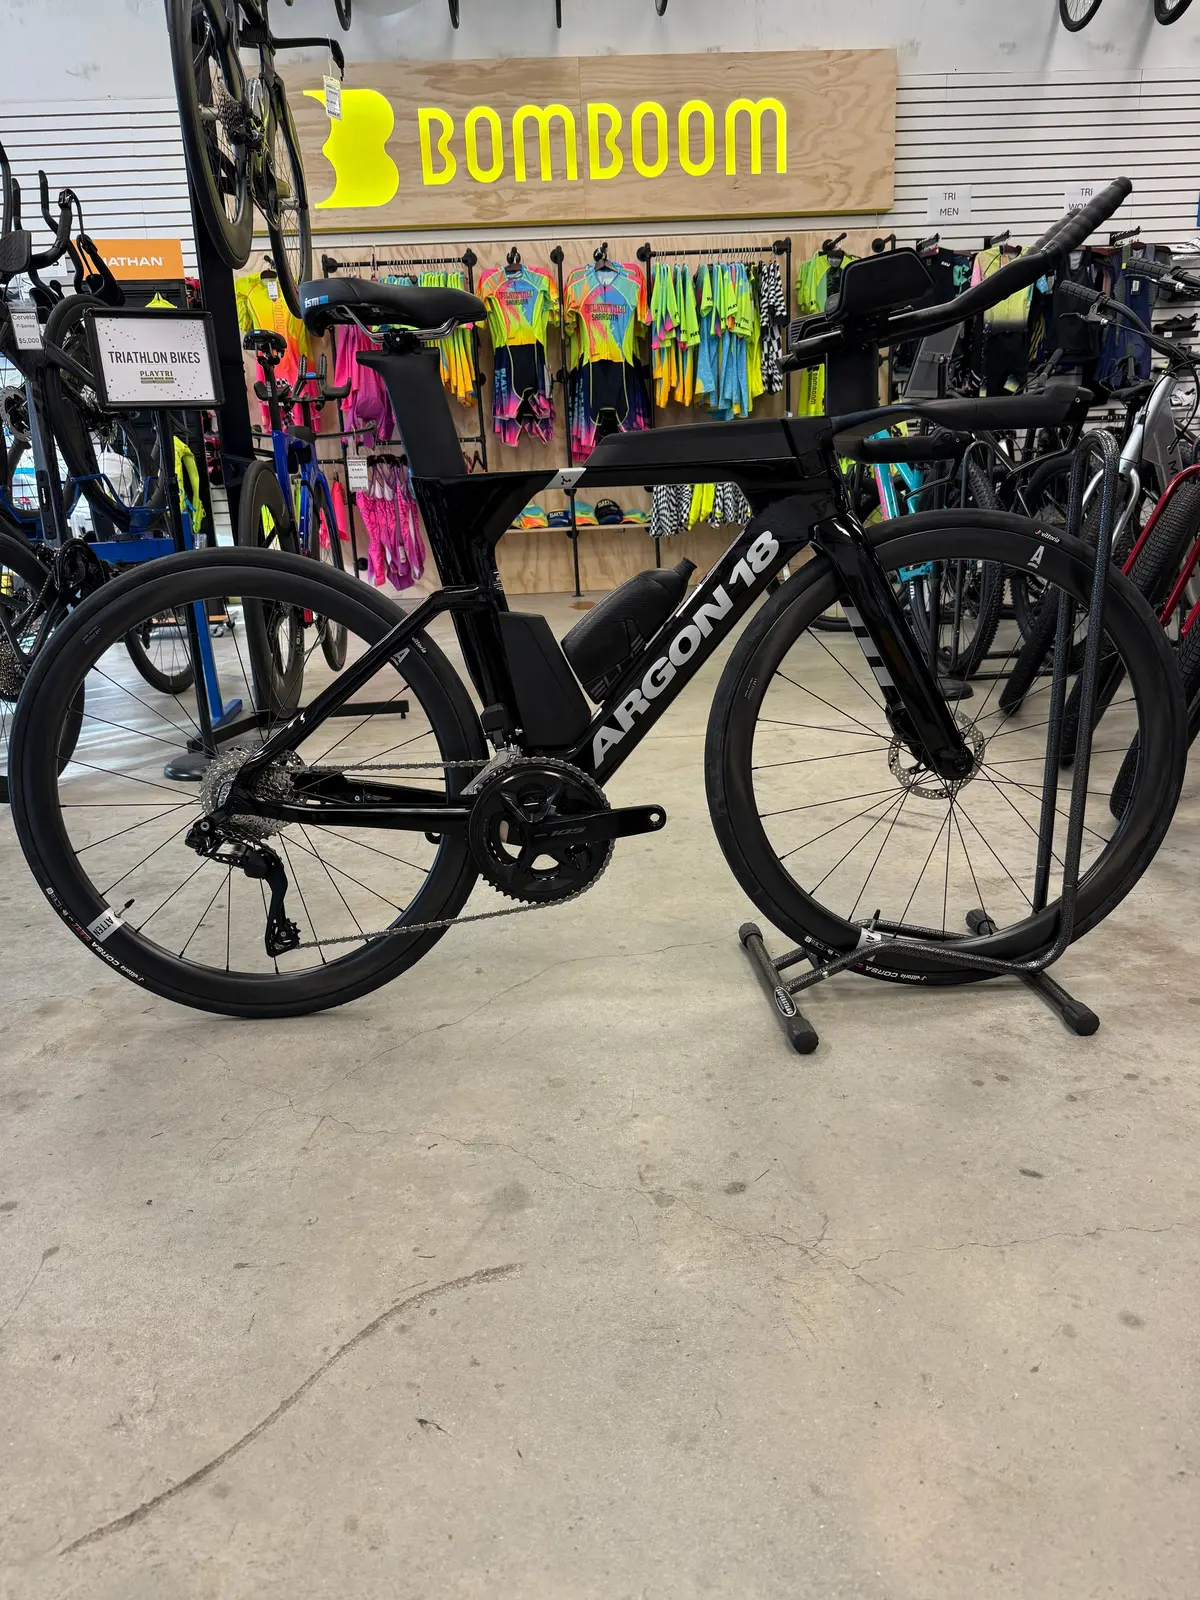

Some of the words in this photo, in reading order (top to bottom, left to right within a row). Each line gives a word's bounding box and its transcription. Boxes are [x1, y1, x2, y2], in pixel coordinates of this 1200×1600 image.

[418, 97, 787, 186] BOMBOOM
[943, 192, 956, 200] TRI
[1080, 188, 1093, 196] TRI
[939, 207, 959, 216] MEN
[108, 351, 168, 364] TRIATHLON
[170, 351, 201, 364] BIKES
[592, 584, 734, 770] ARGON
[728, 530, 780, 588] 18
[91, 941, 120, 967] CORSA
[865, 964, 898, 979] CORSA
